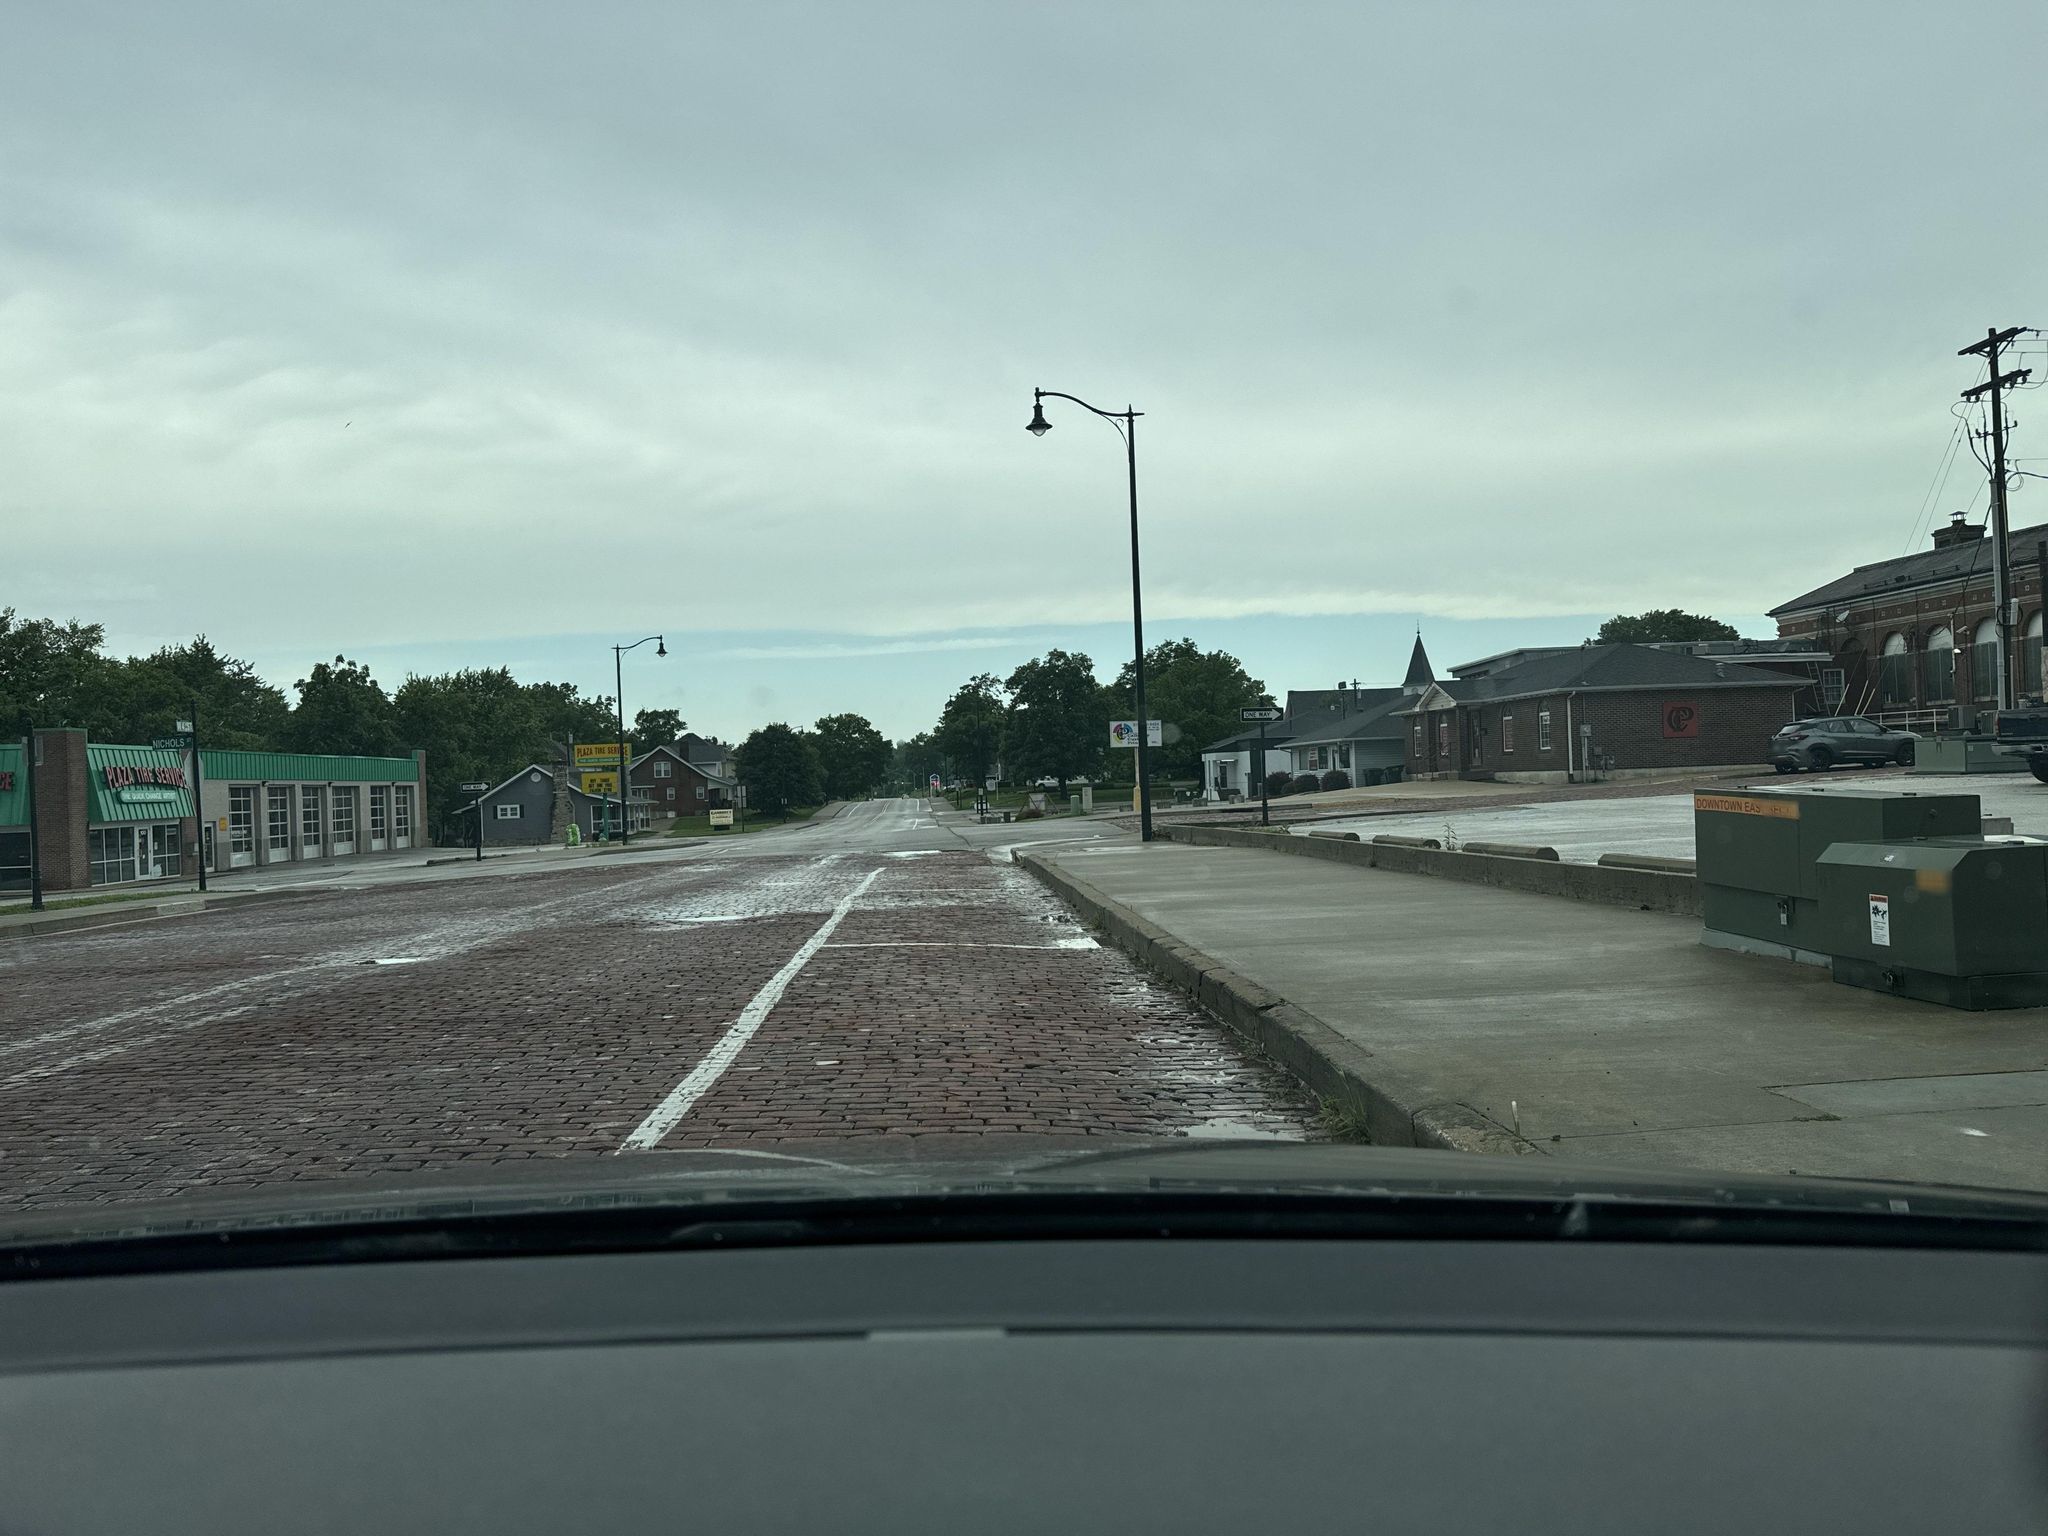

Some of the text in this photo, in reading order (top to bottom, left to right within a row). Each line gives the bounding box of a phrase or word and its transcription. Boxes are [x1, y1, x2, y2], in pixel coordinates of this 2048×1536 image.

[152, 738, 185, 748] NICHOLS
[577, 747, 593, 757] PLAZA
[595, 746, 606, 755] TIRE
[105, 766, 189, 789] PLAZA TIRE SERVICE
[1696, 799, 1743, 811] DOWNTOWN
